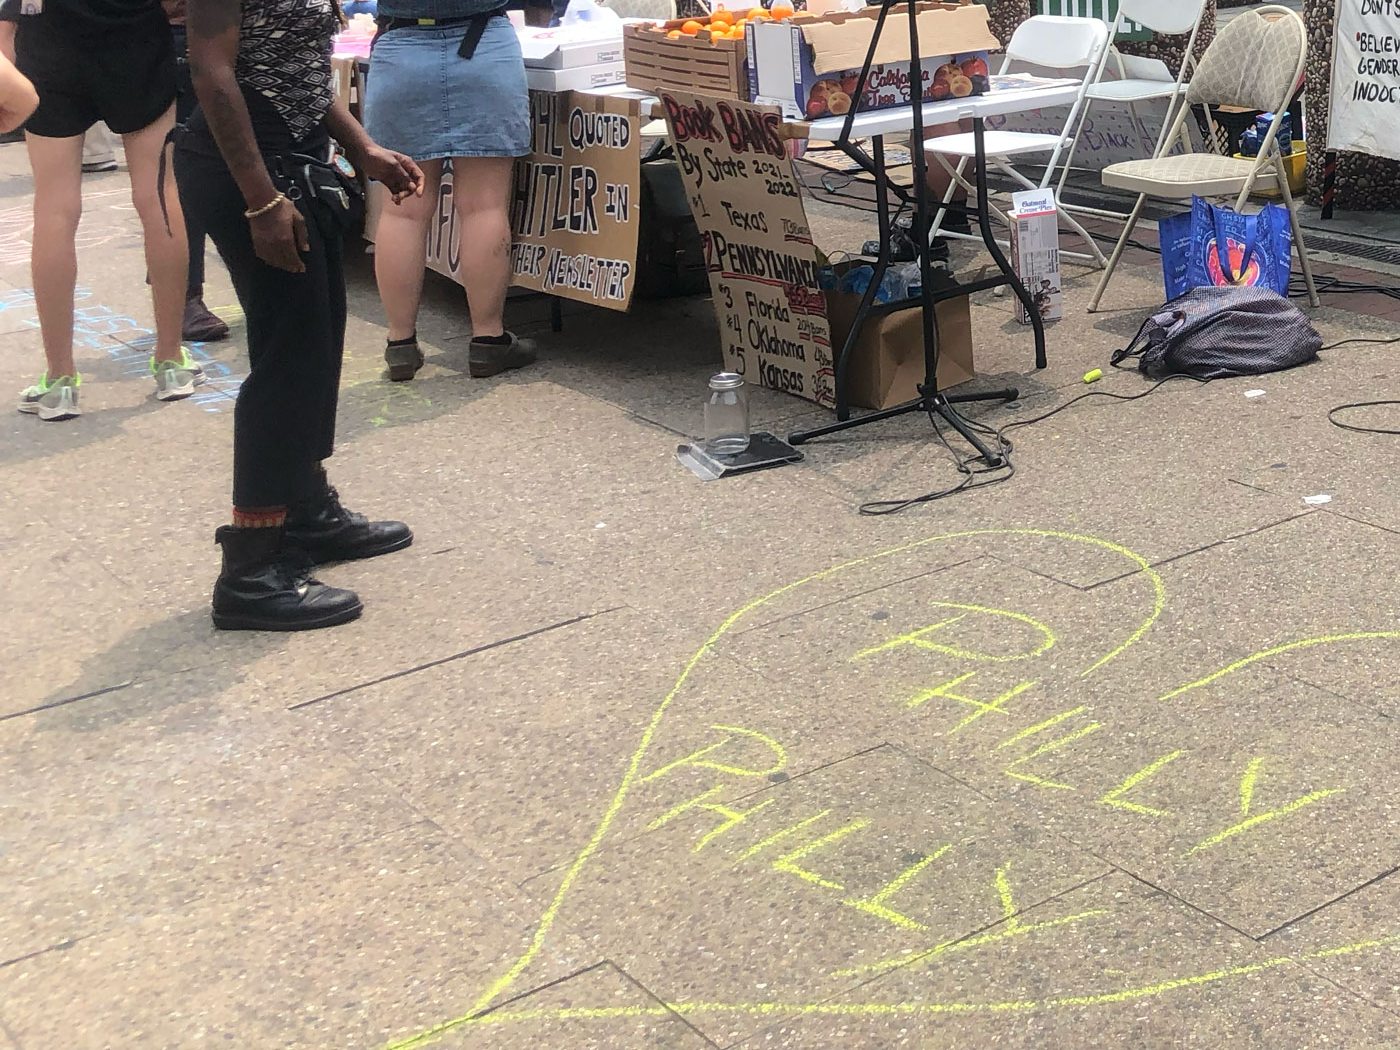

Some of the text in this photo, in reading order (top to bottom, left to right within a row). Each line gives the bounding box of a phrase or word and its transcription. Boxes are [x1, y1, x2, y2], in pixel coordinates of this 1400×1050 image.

[1357, 57, 1400, 77] GENDER
[568, 106, 631, 152] QUOTED
[716, 101, 787, 160] BANS
[676, 142, 703, 189] By
[704, 147, 749, 183] State
[765, 179, 798, 198] 2022
[513, 160, 599, 238] HITLER
[604, 184, 630, 223] IN
[720, 200, 769, 234] Texas
[511, 242, 631, 300] THEIR NEWSLETTER
[711, 230, 821, 290] PENNSYLVANIA
[745, 291, 790, 323] Florida
[758, 355, 804, 393] Kansas
